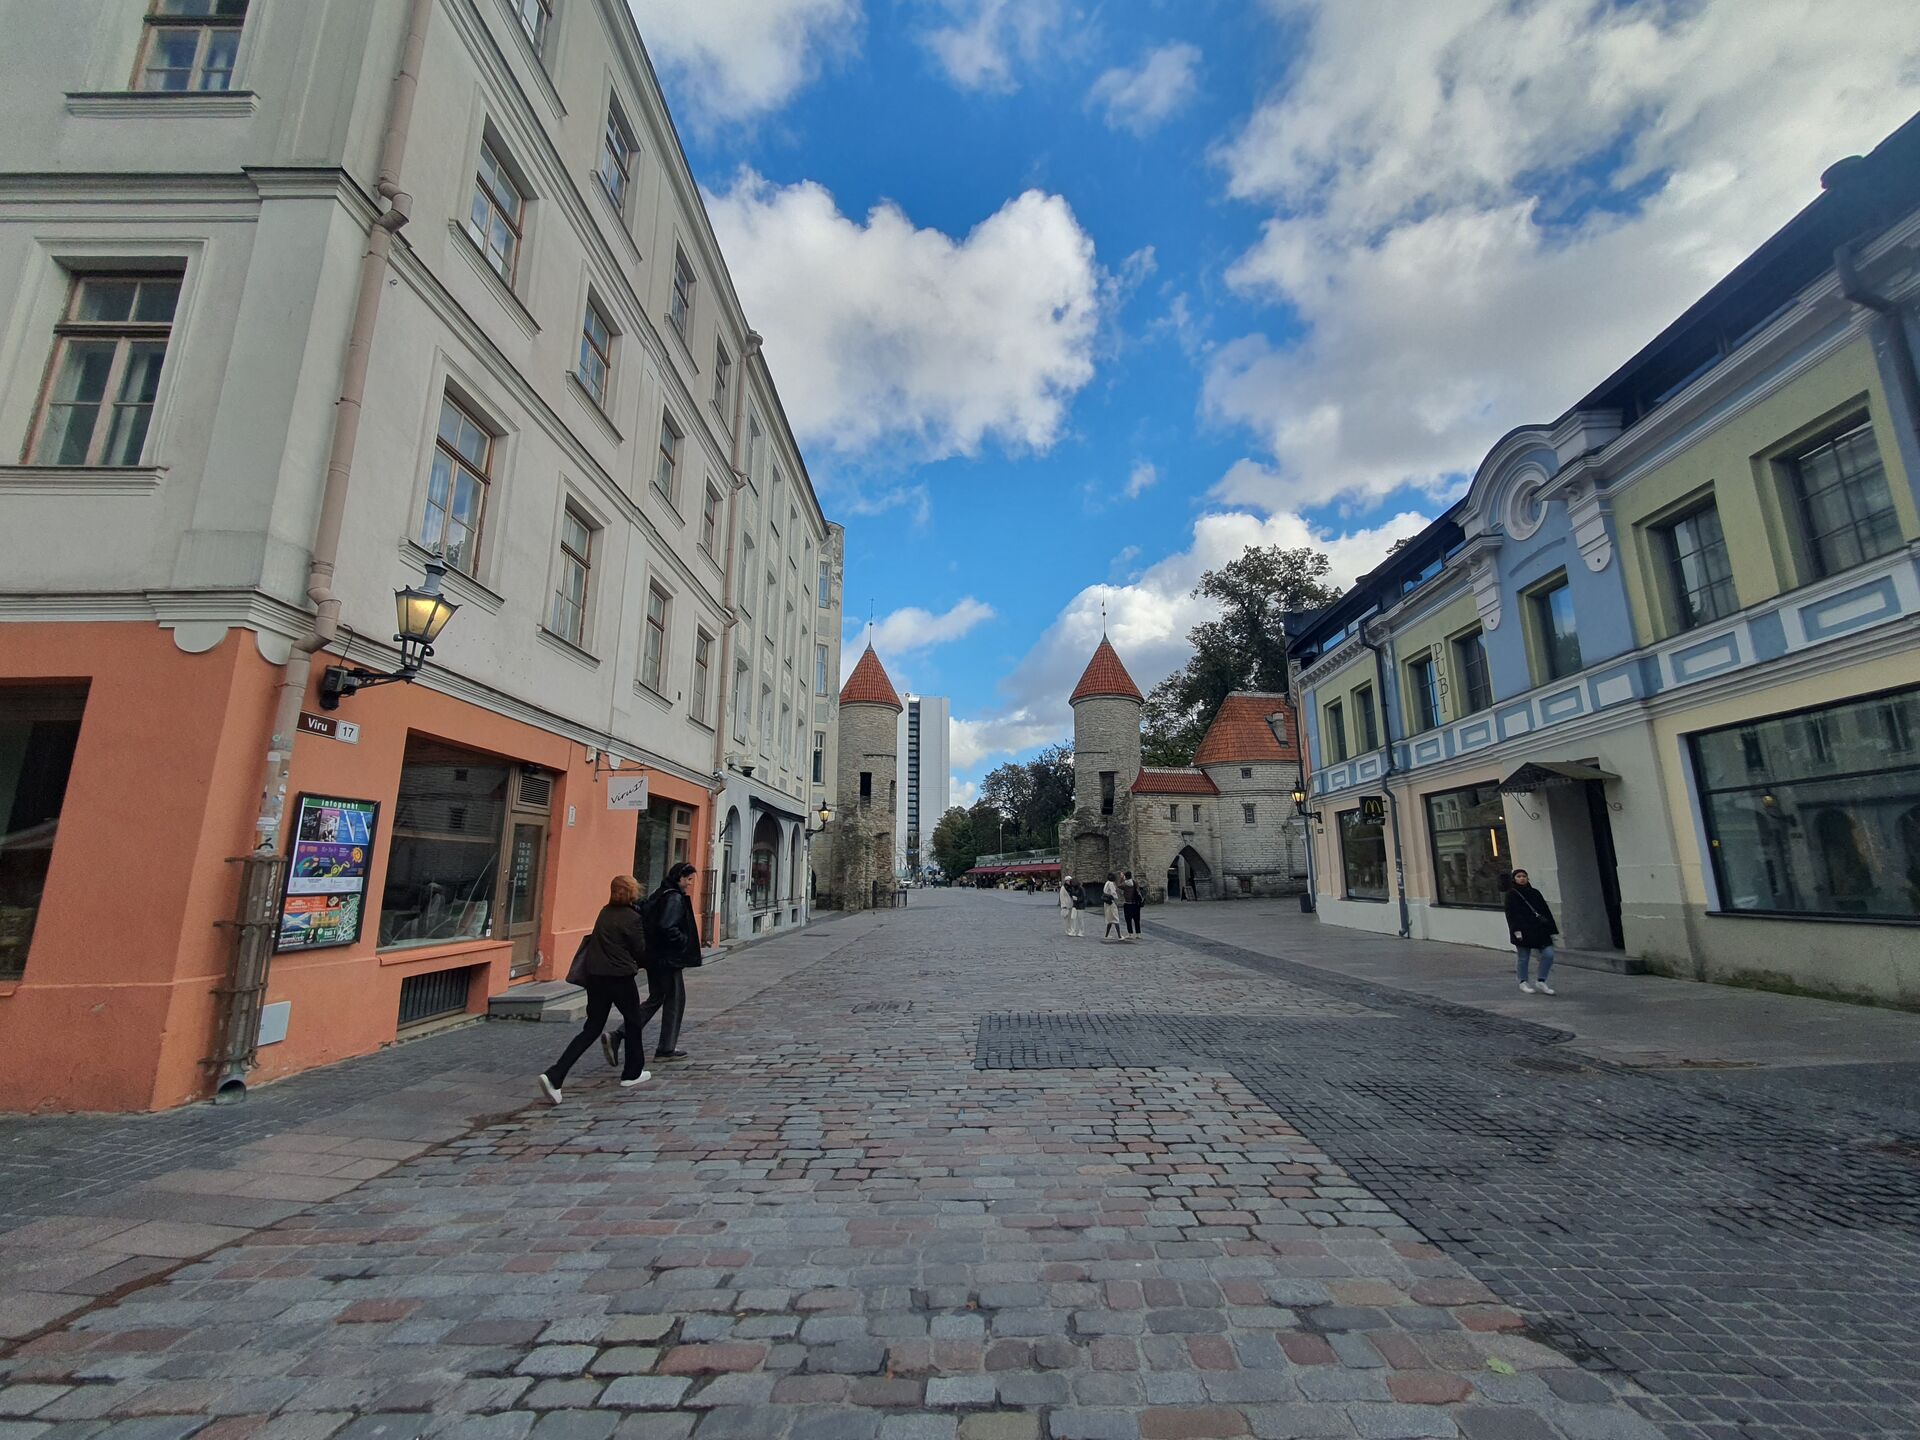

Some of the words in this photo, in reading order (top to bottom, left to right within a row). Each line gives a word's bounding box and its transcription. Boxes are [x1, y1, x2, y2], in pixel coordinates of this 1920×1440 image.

[1432, 642, 1449, 714] PUBI
[308, 717, 328, 732] Viru
[343, 726, 354, 738] 17
[321, 799, 359, 810] infopunkt
